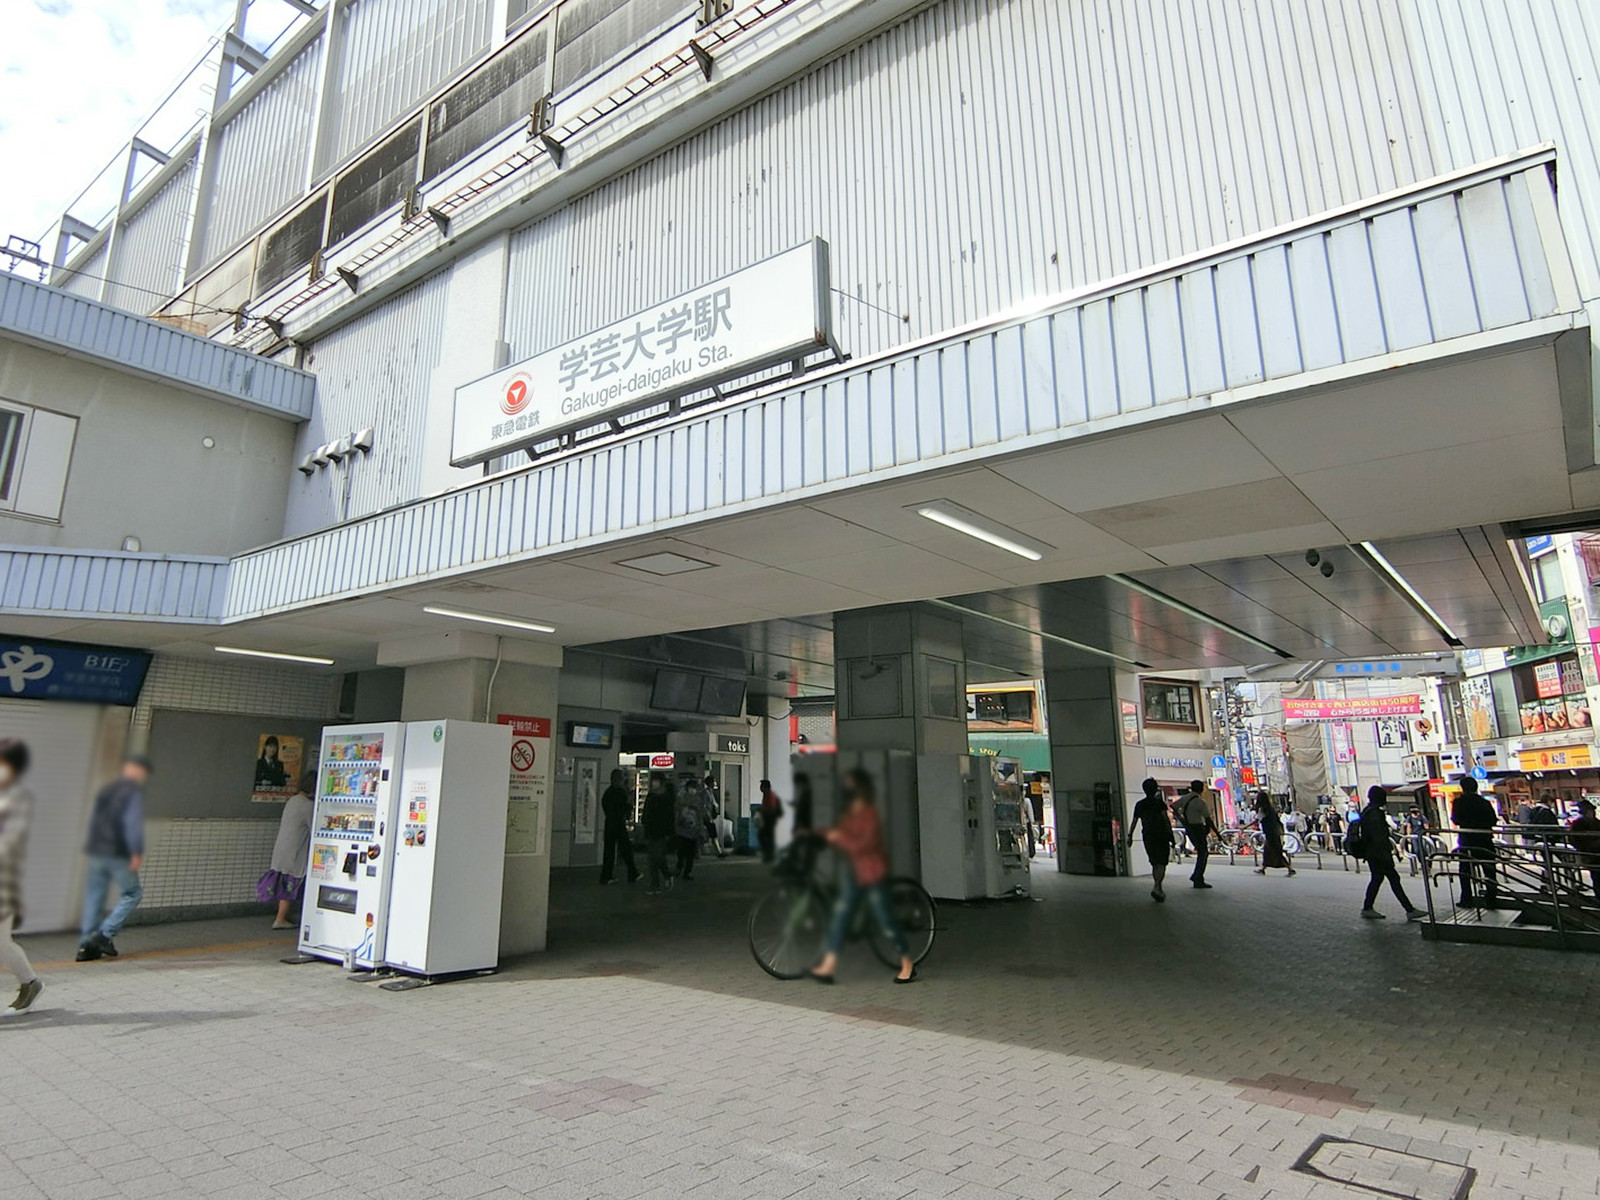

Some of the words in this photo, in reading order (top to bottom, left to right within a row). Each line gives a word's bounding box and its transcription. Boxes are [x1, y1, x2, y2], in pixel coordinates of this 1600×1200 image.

[559, 287, 732, 392] 学芸大学駅
[561, 359, 692, 415] Gakugei-daigaku
[697, 343, 733, 368] Sta.
[491, 410, 540, 440] 東急電鉄
[84, 655, 121, 668] B1F
[727, 740, 747, 753] toks
